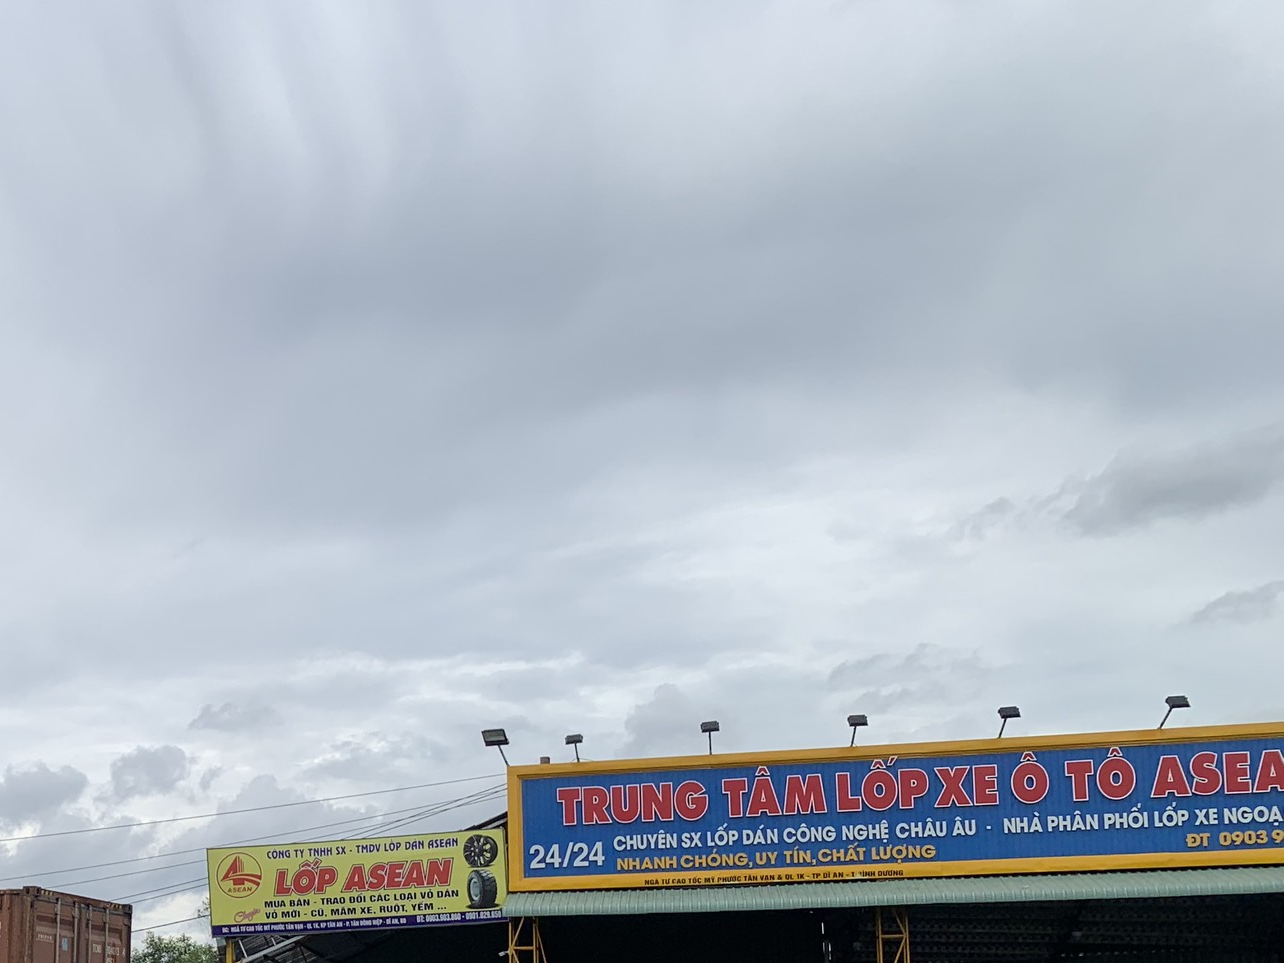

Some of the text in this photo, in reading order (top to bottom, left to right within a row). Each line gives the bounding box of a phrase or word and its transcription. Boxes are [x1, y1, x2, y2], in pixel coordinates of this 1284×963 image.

[556, 780, 708, 826] TRUNG
[721, 766, 828, 818] TÂM
[835, 756, 929, 812] LỐP
[934, 764, 999, 808] XE
[1011, 751, 1049, 804] Ô
[1065, 747, 1136, 802] TÔ
[613, 830, 678, 851] CHUYÊN
[681, 832, 702, 849] SX
[707, 823, 739, 846] LỐP
[742, 824, 779, 845] DÁN
[783, 823, 836, 843] CÔNG
[841, 819, 889, 843] NGHỆ
[896, 817, 947, 838] CHÂU
[952, 816, 977, 836] ÂU
[1003, 811, 1043, 834] NHÀ
[1048, 810, 1099, 832] PHÂN
[1104, 803, 1149, 829] PHỐI
[1154, 802, 1189, 827] LỐP
[1194, 808, 1219, 826] XE
[1186, 833, 1210, 848] ĐT
[1219, 830, 1268, 846] 0903
[267, 848, 291, 859] CÔNG
[294, 849, 305, 858] TY
[308, 847, 332, 857] TNHH
[336, 846, 346, 855] SX
[356, 844, 381, 853] TMDV
[428, 838, 458, 849] ASEAN
[529, 841, 606, 869] 24/24
[617, 842, 936, 871] NHANH CHÓNG, UY TÍN, CHẤT LƯỢNG
[274, 857, 454, 897] LỐP ASEAN
[264, 899, 286, 908] MUA
[290, 897, 310, 907] BÁN
[320, 896, 346, 905] TRAO
[369, 890, 390, 902] CÁC
[437, 888, 459, 898] DÁN
